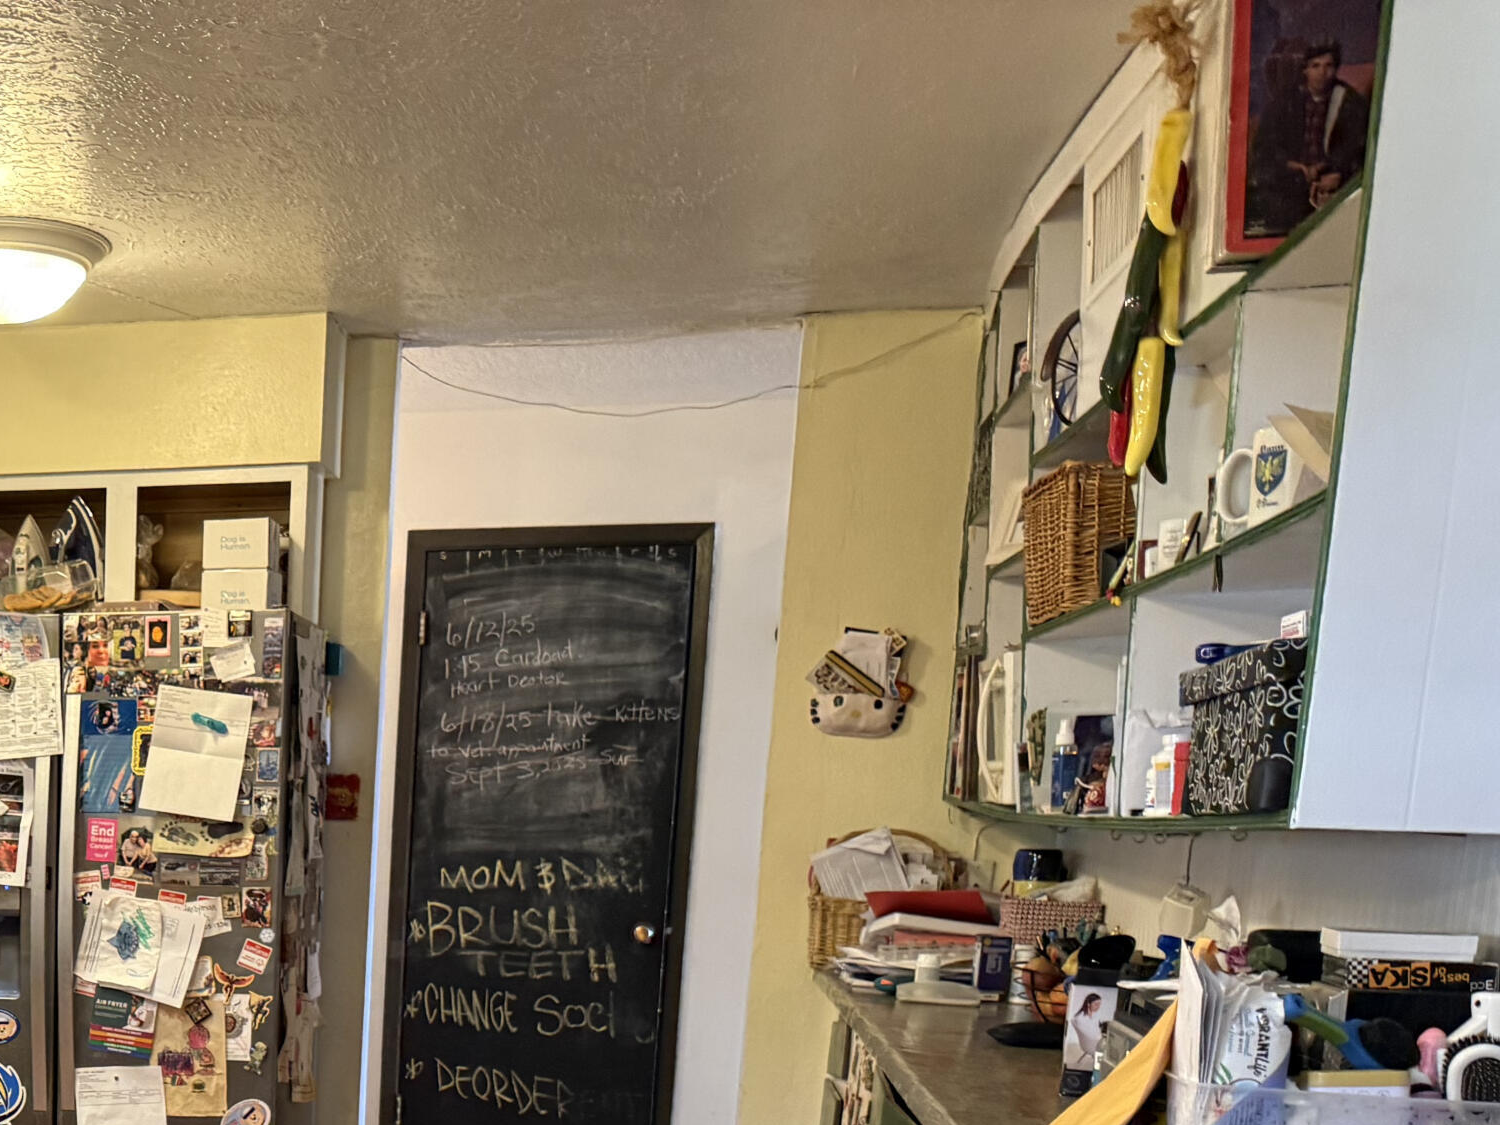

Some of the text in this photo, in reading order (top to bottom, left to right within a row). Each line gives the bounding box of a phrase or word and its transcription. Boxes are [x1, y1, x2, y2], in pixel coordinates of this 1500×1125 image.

[445, 611, 537, 648] 6/12/25
[91, 825, 115, 837] End
[440, 859, 525, 893] MOM
[425, 901, 579, 957] BRUSH
[462, 944, 618, 983] TEETH
[1369, 964, 1429, 988] SKA
[1438, 971, 1470, 985] best
[423, 982, 518, 1033] CHANGE
